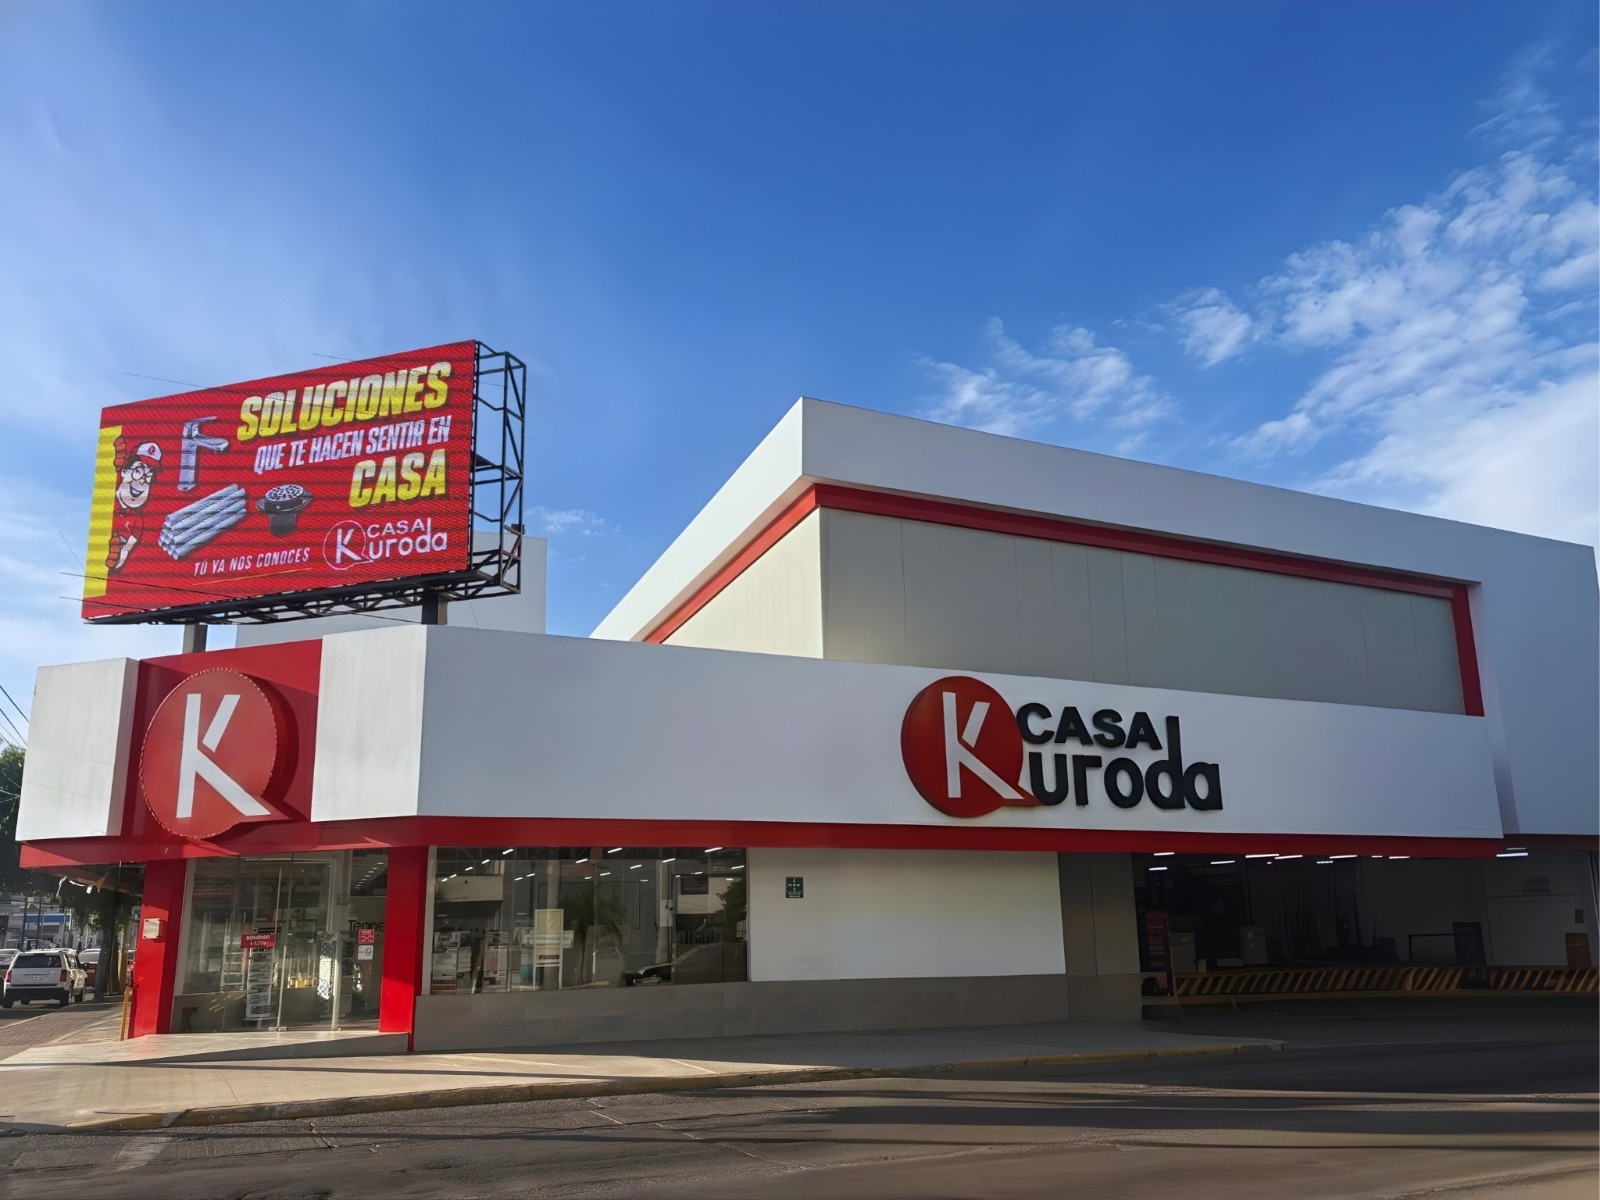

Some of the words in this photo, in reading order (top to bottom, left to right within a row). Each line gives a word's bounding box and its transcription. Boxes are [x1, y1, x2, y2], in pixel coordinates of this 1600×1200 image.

[237, 362, 451, 441] SOLUCIONES
[254, 442, 287, 474] QUE
[289, 439, 308, 467] TE
[309, 429, 364, 463] HACEN
[366, 419, 425, 454] SENTIR
[427, 415, 452, 444] EN
[349, 449, 446, 508] CASA
[367, 518, 425, 538] CASA
[194, 559, 207, 576] TÚ
[212, 559, 225, 574] YA
[229, 555, 253, 571] NOS
[256, 547, 310, 568] CONOCES
[1016, 702, 1163, 750] CASA
[176, 693, 271, 819] K
